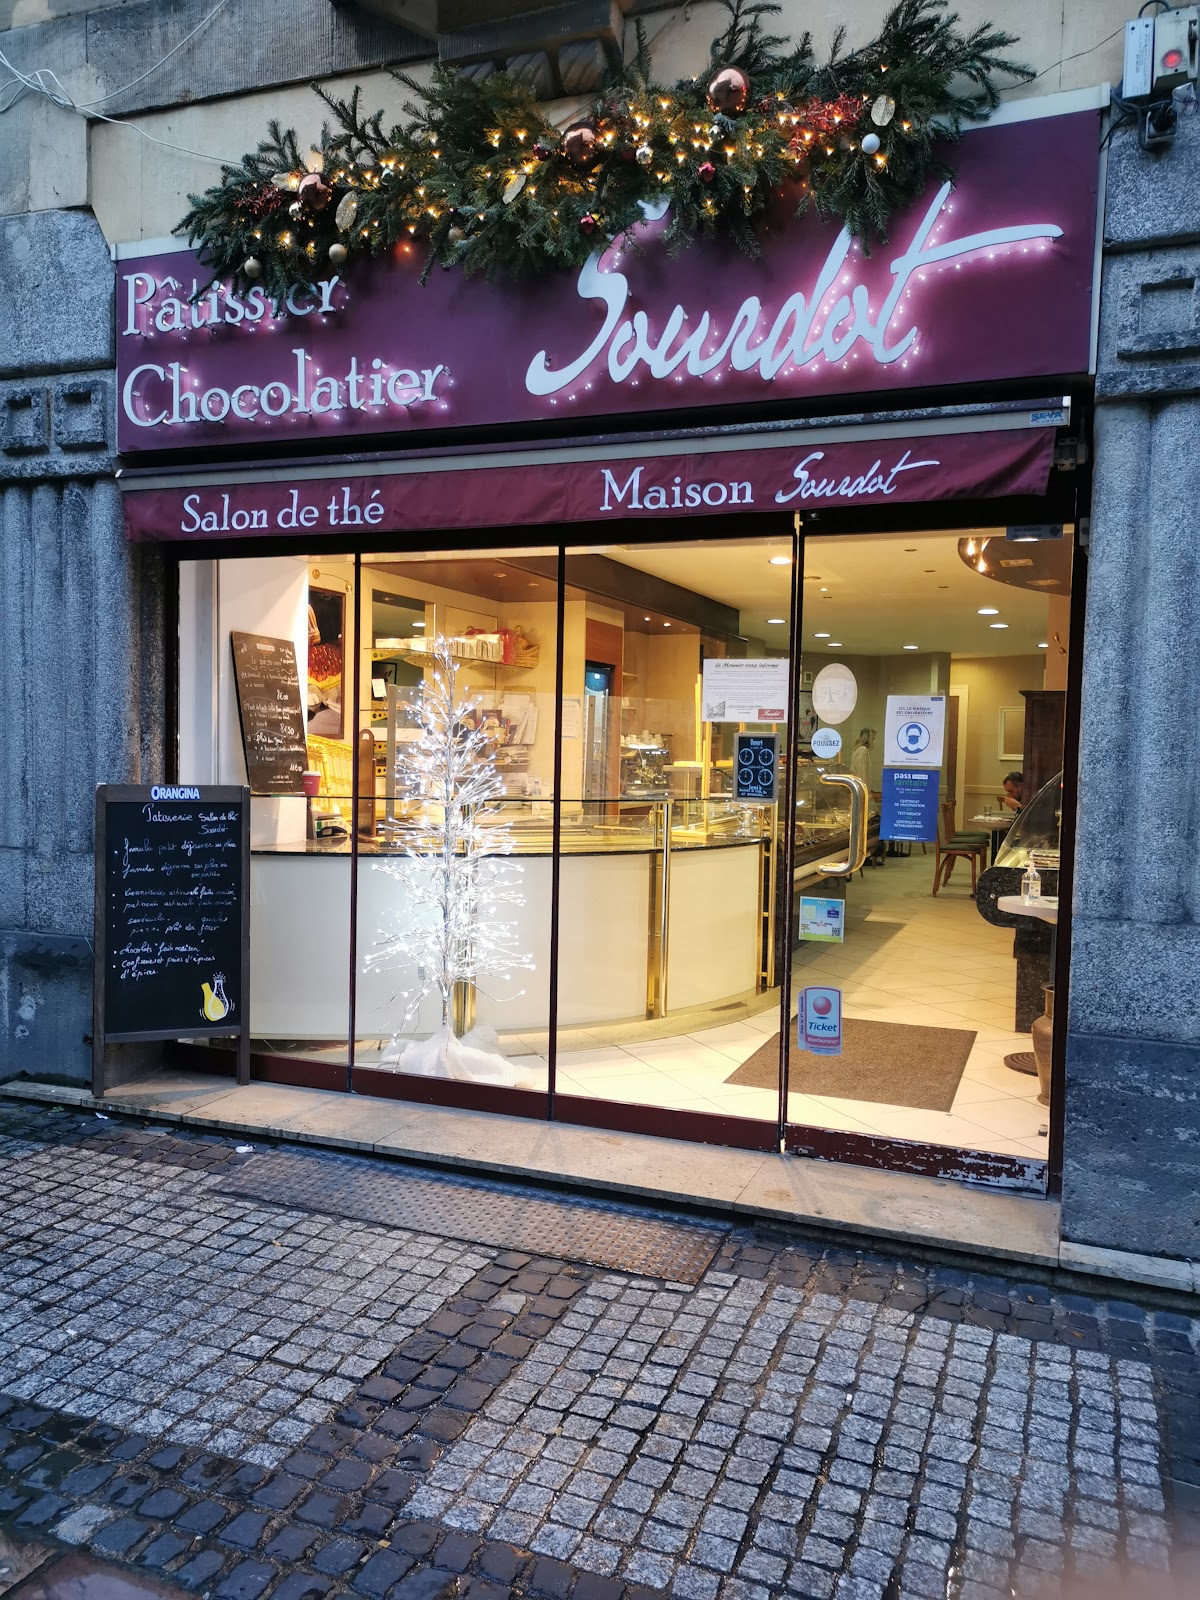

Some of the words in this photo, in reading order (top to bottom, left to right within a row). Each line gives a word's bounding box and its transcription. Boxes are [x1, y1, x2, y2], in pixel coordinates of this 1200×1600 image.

[122, 272, 340, 336] Pâtisser
[525, 181, 1064, 396] Sourdot
[123, 349, 444, 428] Chocolatier
[600, 466, 754, 511] Maison
[776, 450, 940, 503] Sourdot
[181, 494, 269, 533] Salon
[277, 489, 319, 528] de
[327, 487, 385, 525] thé
[151, 785, 201, 801] ORANGINA
[894, 773, 911, 781] pass
[808, 1021, 838, 1032] Ticket
